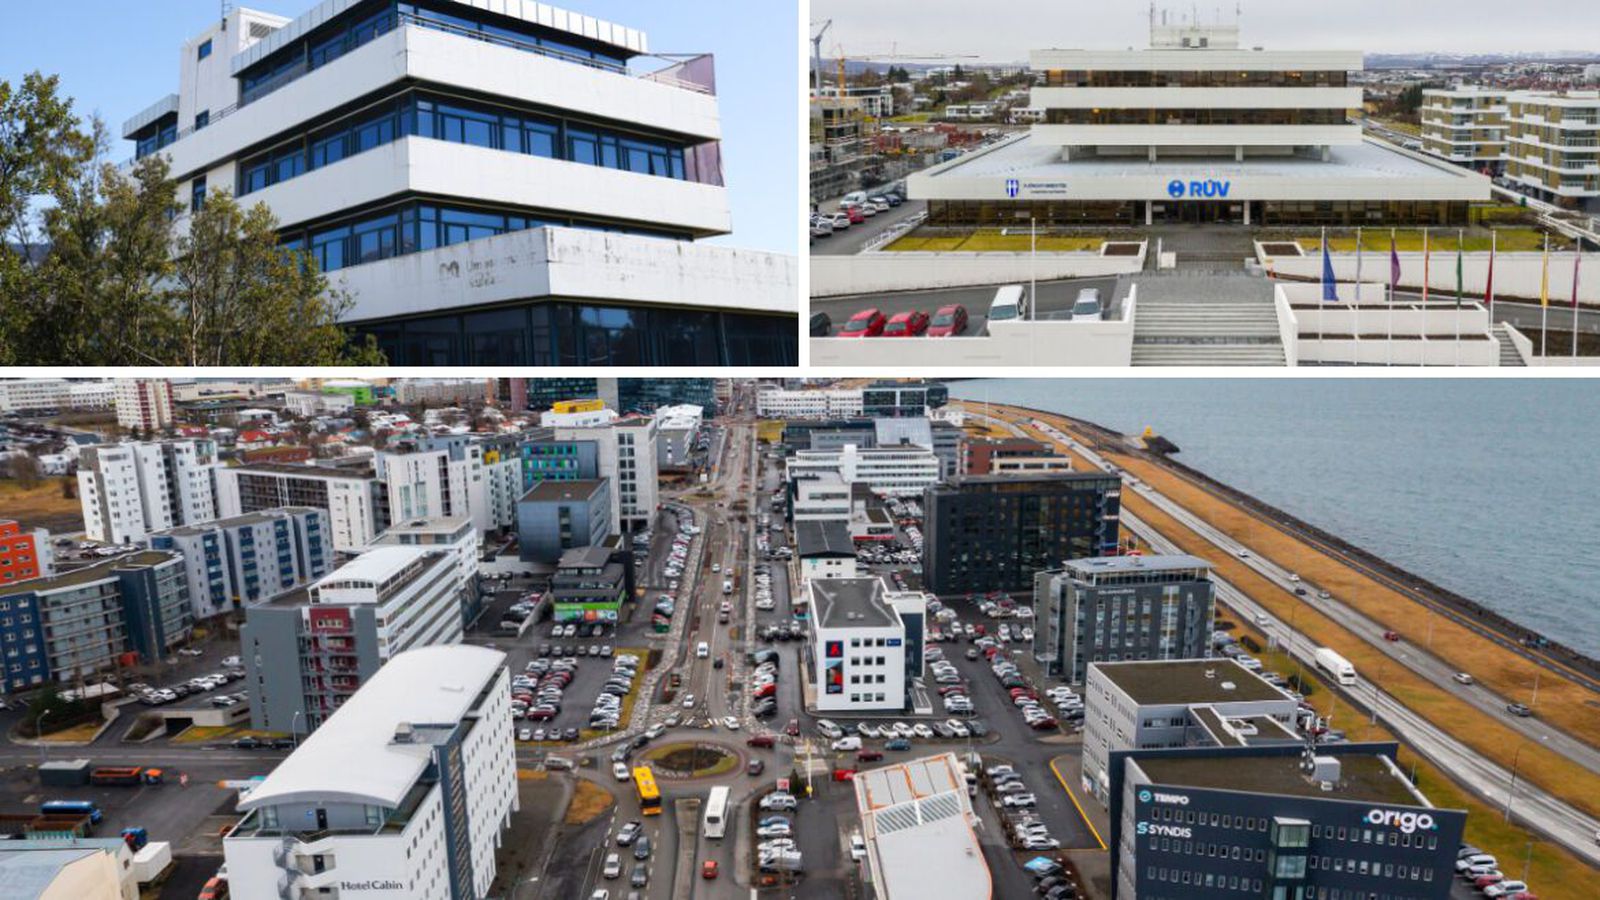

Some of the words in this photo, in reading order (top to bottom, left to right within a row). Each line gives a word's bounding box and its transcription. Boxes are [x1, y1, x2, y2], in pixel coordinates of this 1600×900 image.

[1154, 793, 1189, 805] TEMPO
[1368, 809, 1433, 834] origo
[1149, 824, 1192, 838] SYNDIS
[341, 880, 370, 891] Hotel
[371, 880, 403, 890] Cabin
